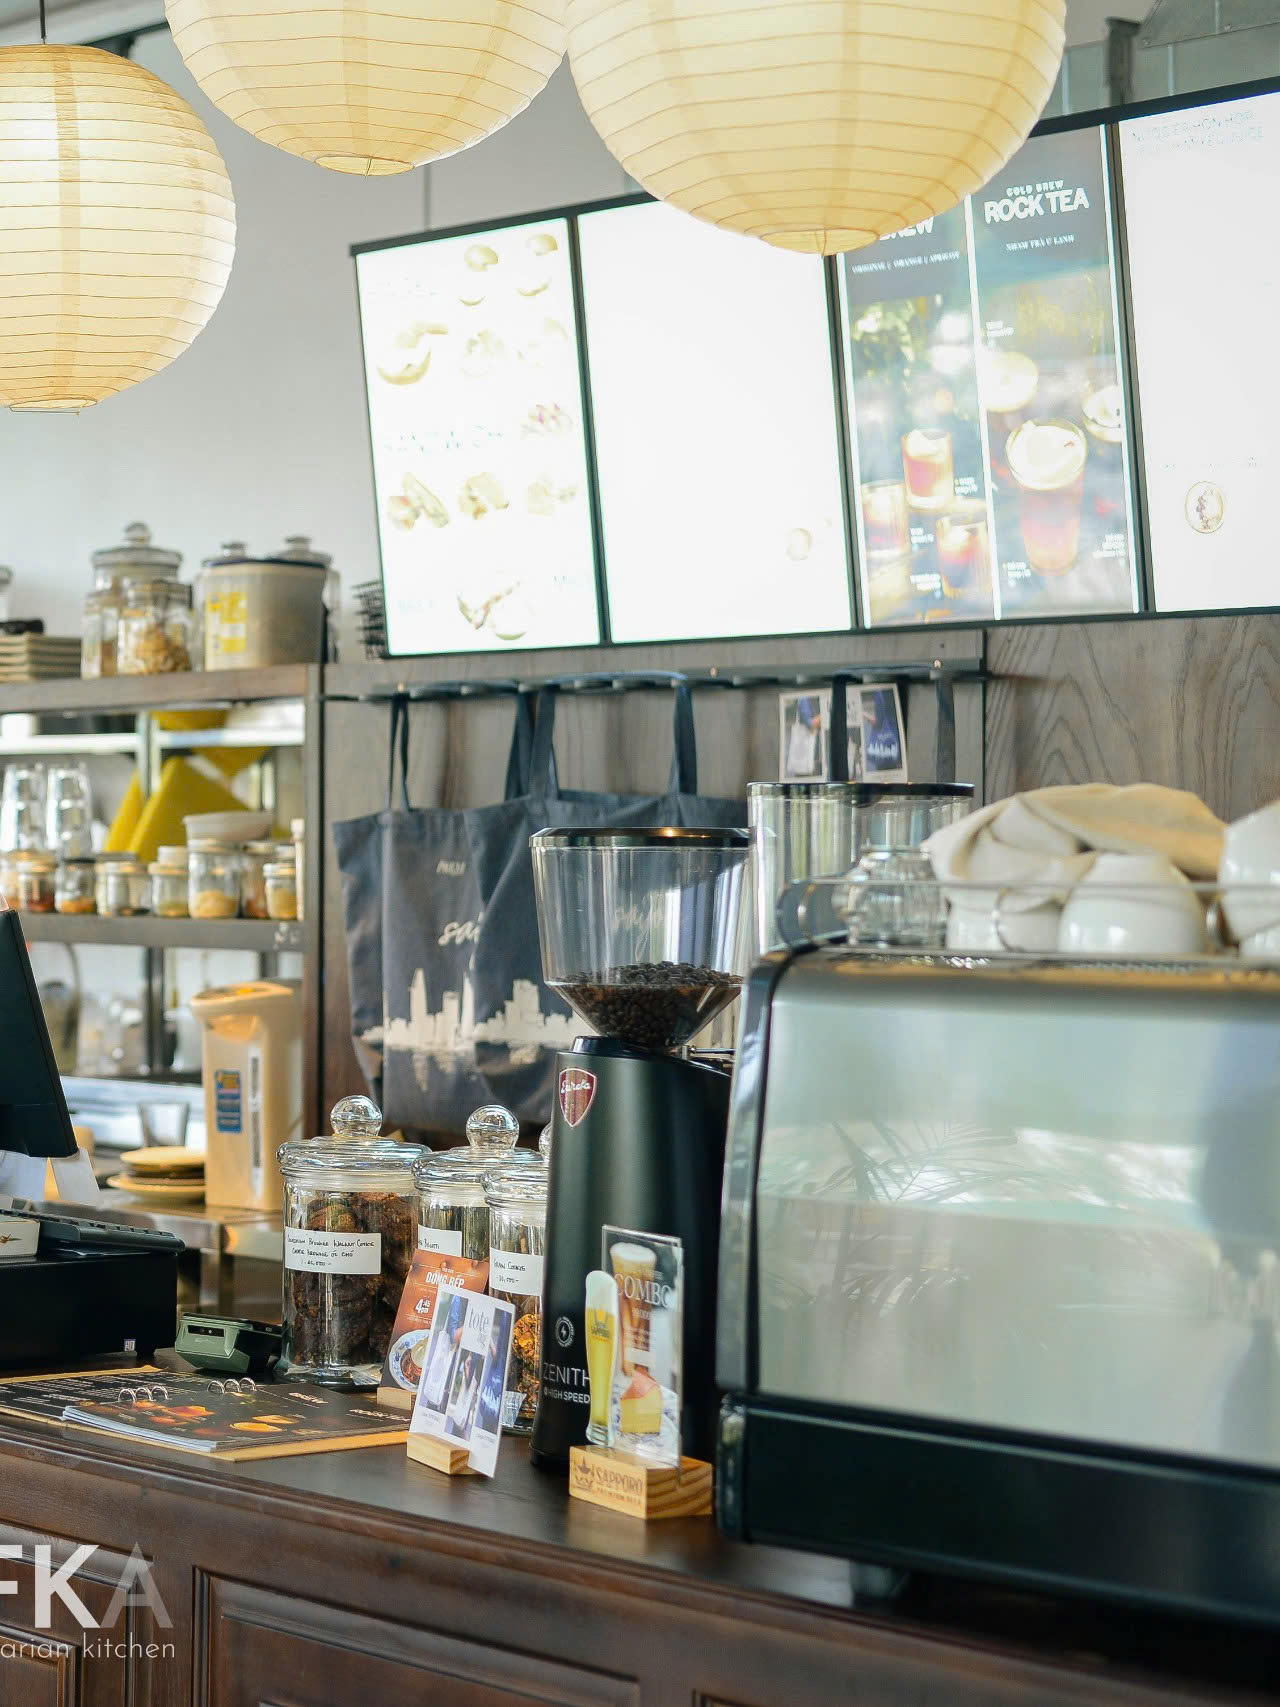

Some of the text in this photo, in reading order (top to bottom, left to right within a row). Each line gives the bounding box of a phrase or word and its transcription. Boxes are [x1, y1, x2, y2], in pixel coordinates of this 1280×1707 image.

[984, 187, 1090, 225] ROCK TEA
[468, 1308, 490, 1332] tote
[563, 1391, 591, 1404] SPEED
